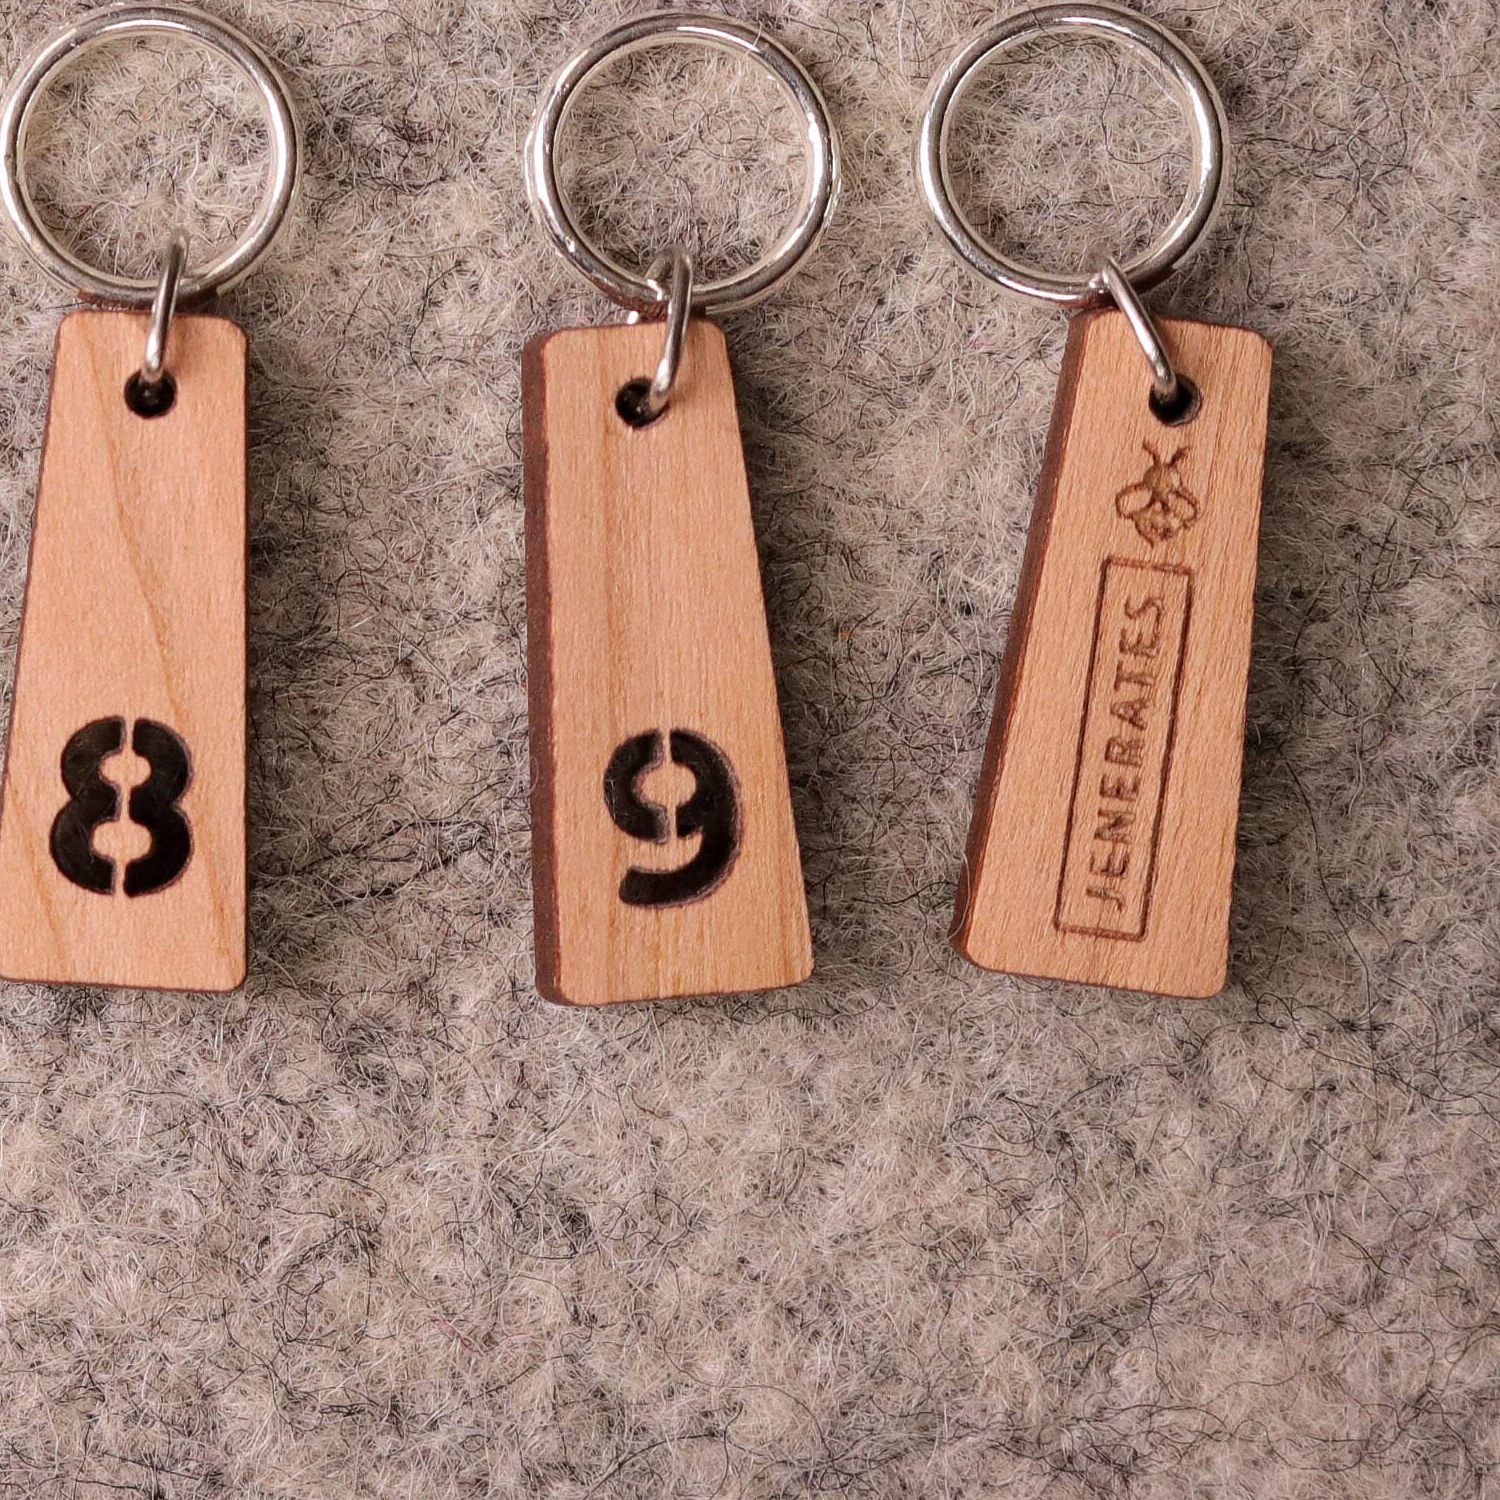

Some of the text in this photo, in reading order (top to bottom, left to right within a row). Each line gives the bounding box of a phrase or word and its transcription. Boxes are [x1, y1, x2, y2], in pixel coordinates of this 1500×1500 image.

[49, 716, 193, 898] 8
[603, 728, 744, 911] 9
[1086, 595, 1164, 912] JENERATES
